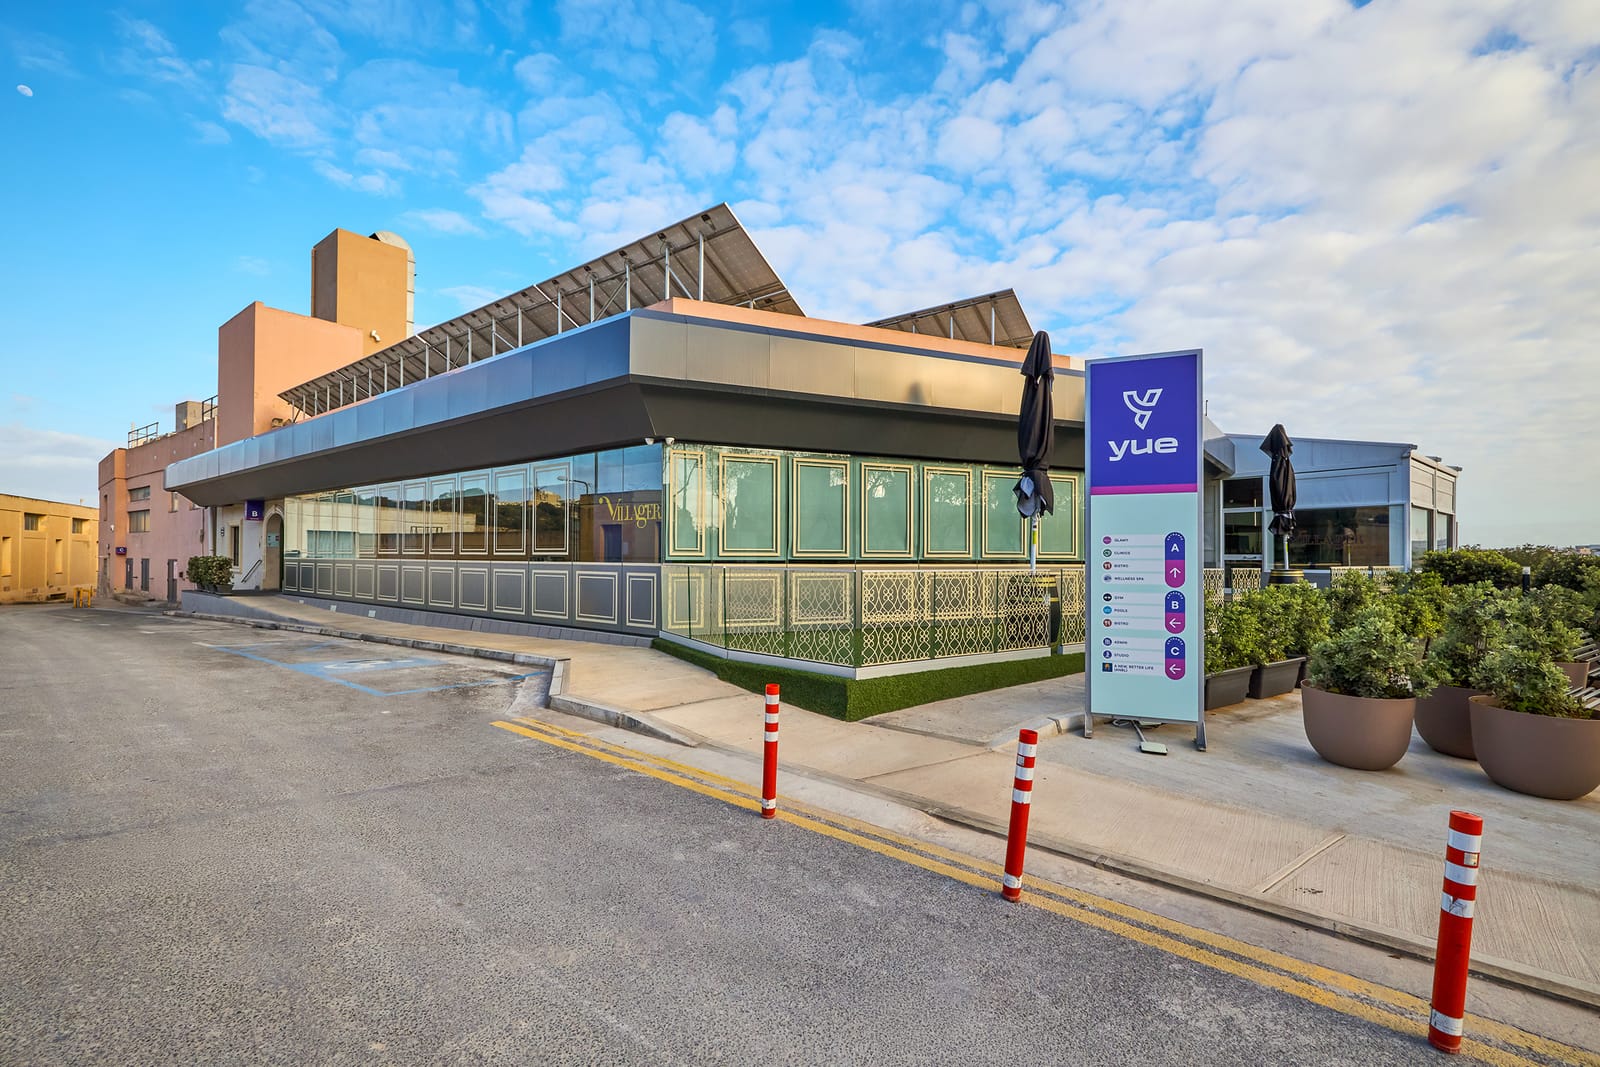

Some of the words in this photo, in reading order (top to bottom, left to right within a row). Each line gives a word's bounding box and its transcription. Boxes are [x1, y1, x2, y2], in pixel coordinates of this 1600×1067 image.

[1108, 437, 1178, 462] yue
[598, 496, 662, 528] VILLAGER
[1170, 544, 1180, 552] A
[1171, 600, 1180, 610] B
[1170, 646, 1180, 656] C
